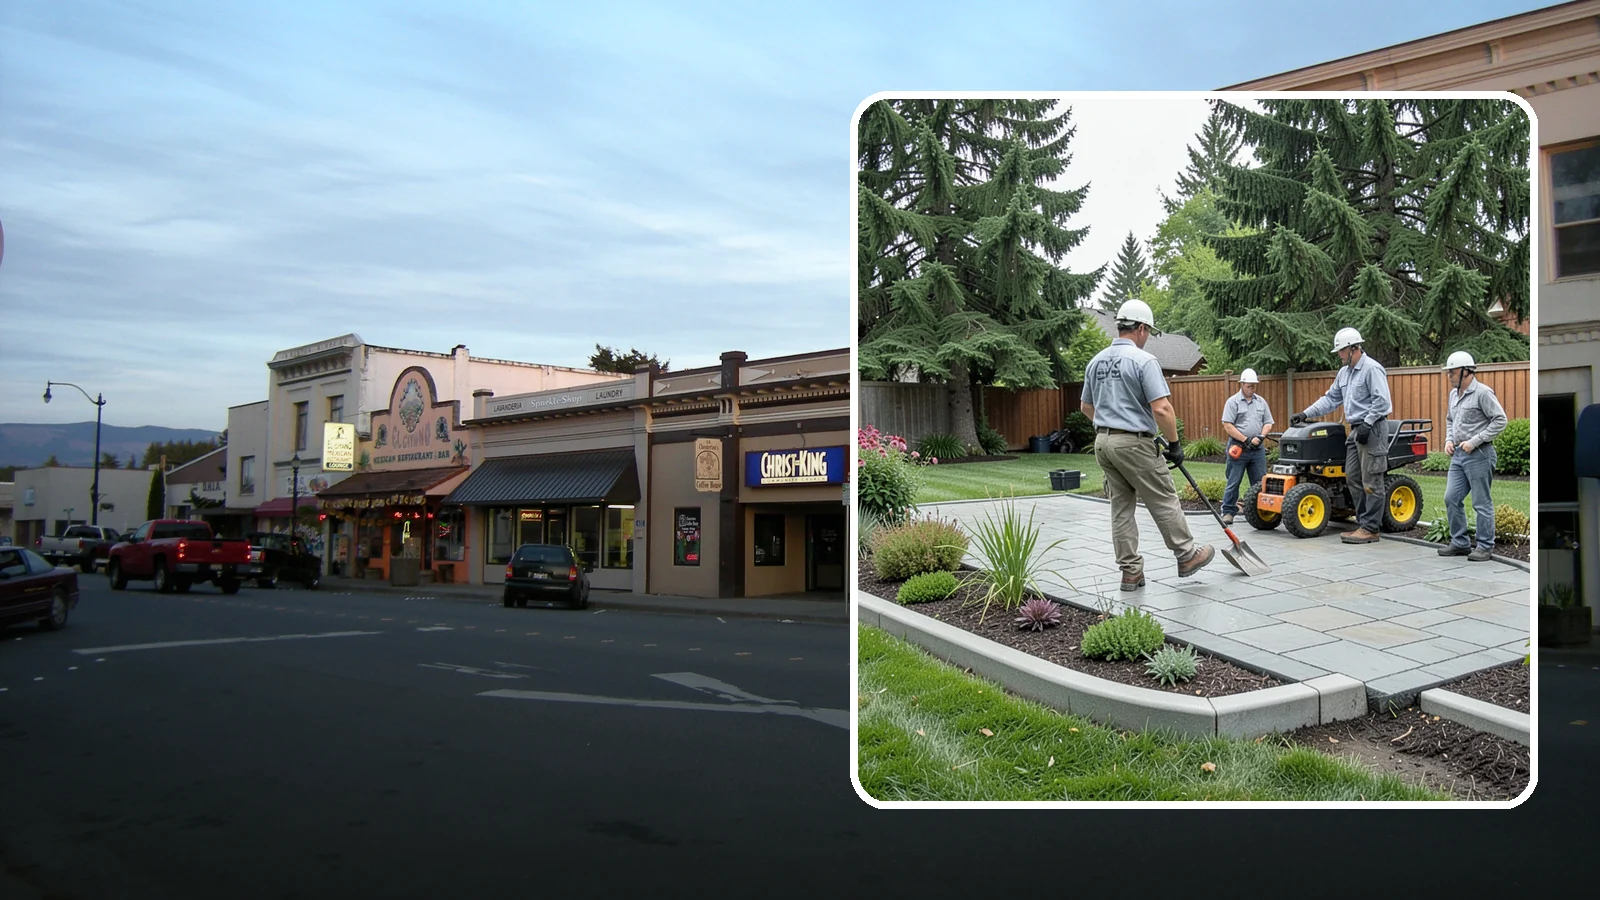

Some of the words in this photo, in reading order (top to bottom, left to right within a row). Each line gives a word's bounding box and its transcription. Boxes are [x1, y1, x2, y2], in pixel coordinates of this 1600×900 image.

[531, 397, 561, 409] Sparkle
[562, 394, 583, 406] Shop
[596, 389, 623, 400] LAUNDRY
[494, 402, 523, 412] LAVANDERIA
[373, 455, 397, 464] MEXICAN
[398, 451, 433, 463] RESTAURANT
[438, 450, 450, 459] BAR
[761, 452, 796, 478] CHRIST
[799, 450, 827, 476] KING
